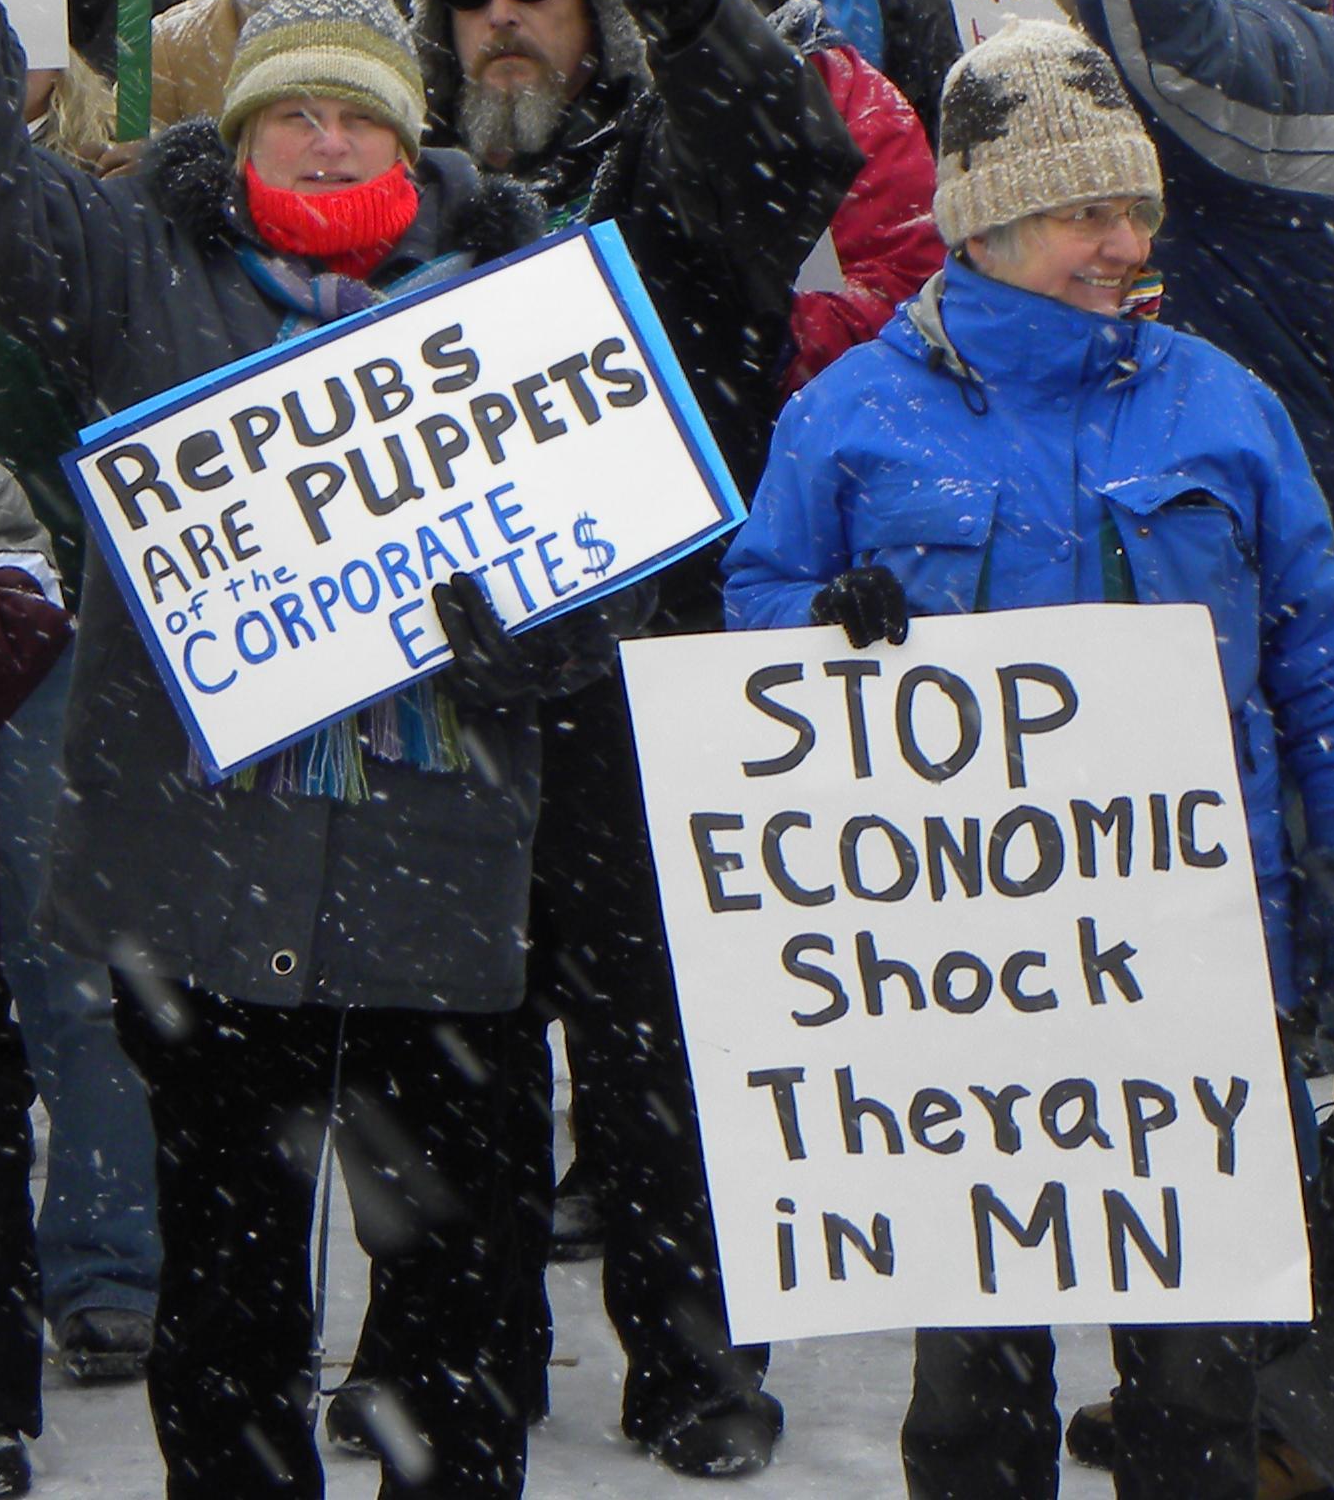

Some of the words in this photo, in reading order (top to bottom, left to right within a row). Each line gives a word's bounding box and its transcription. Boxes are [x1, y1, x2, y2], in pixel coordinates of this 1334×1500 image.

[142, 498, 264, 605] ARE
[286, 336, 649, 546] PUPPETS
[165, 593, 210, 637] of
[224, 563, 297, 609] the
[182, 481, 536, 695] CORPORATE
[388, 511, 617, 669] ETE$
[740, 659, 1079, 789] STOP
[689, 789, 1229, 914] ECONOMIC
[781, 916, 1145, 1028] Shock
[746, 1064, 1250, 1177] Therapy
[970, 1180, 1183, 1295] MN
